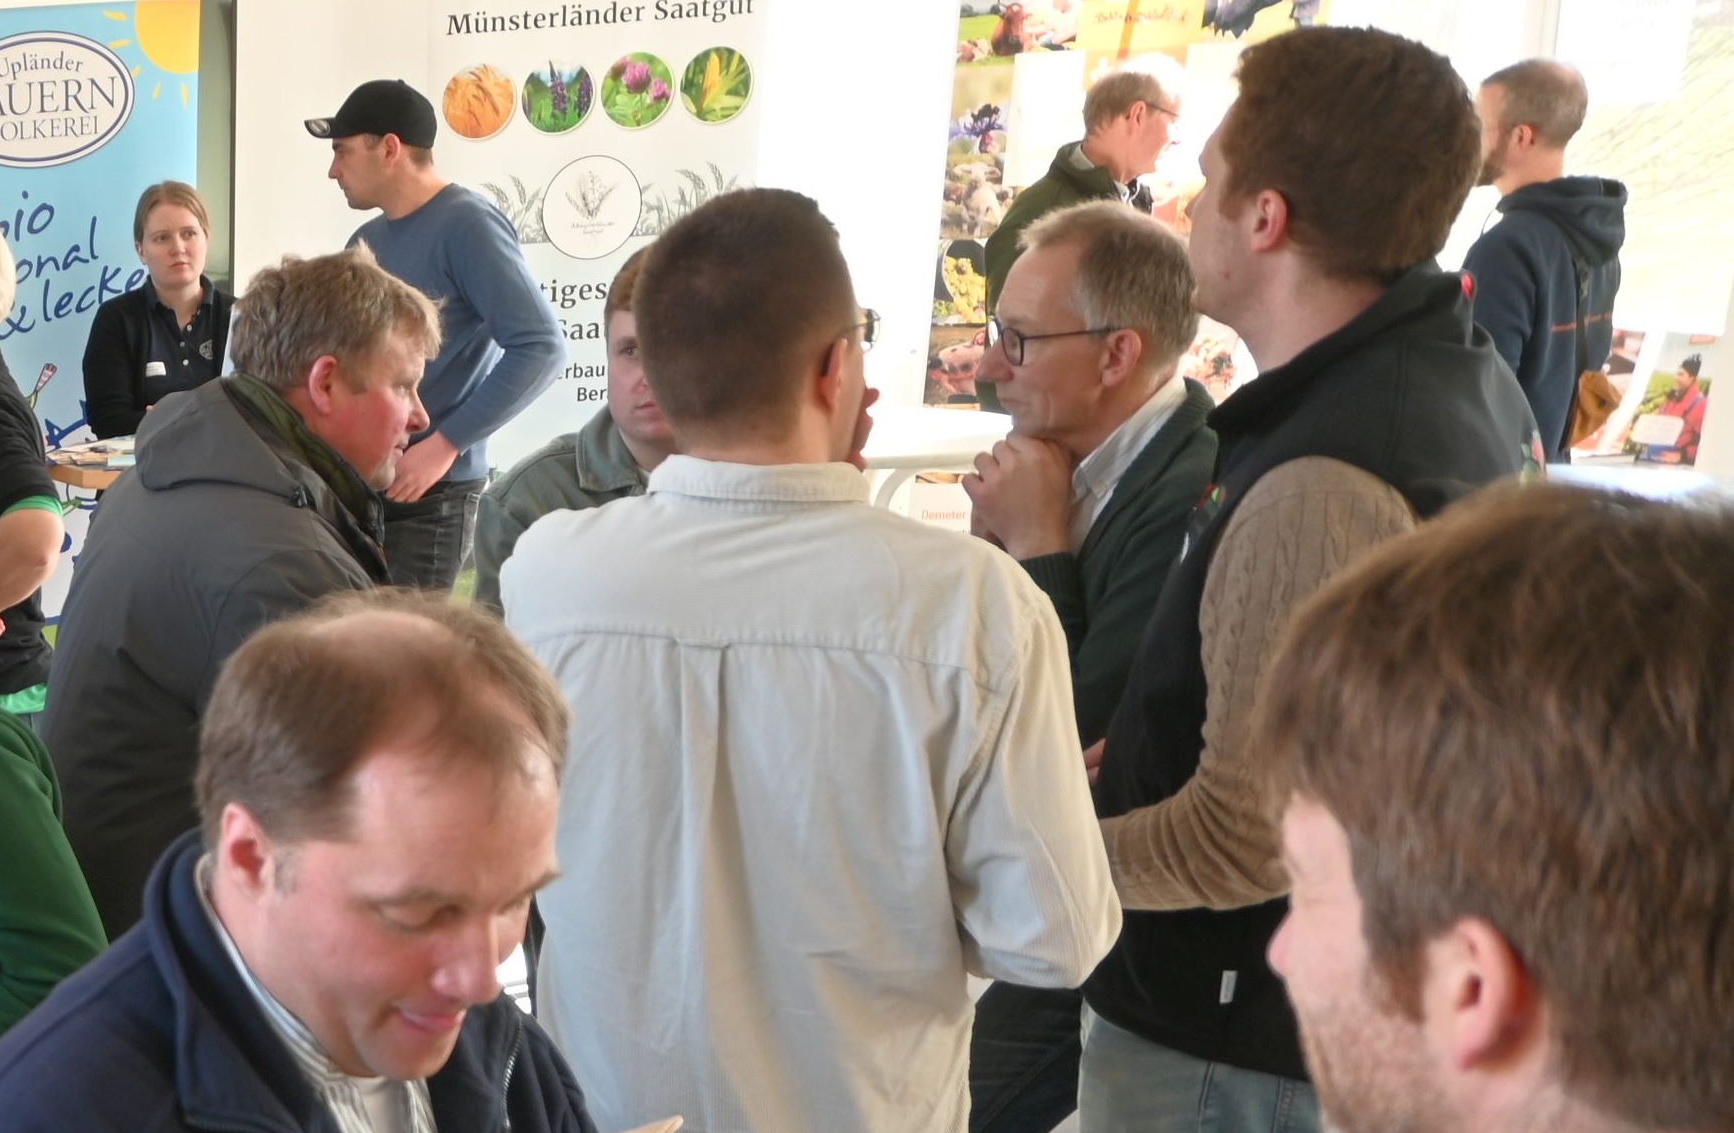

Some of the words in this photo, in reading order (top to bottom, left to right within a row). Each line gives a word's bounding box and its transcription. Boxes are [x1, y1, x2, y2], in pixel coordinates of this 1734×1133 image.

[446, 1, 646, 36] Münsterländer
[654, 0, 754, 23] Saatgut
[558, 362, 606, 380] rbau
[577, 387, 609, 402] Ber
[921, 509, 966, 521] Demeter
